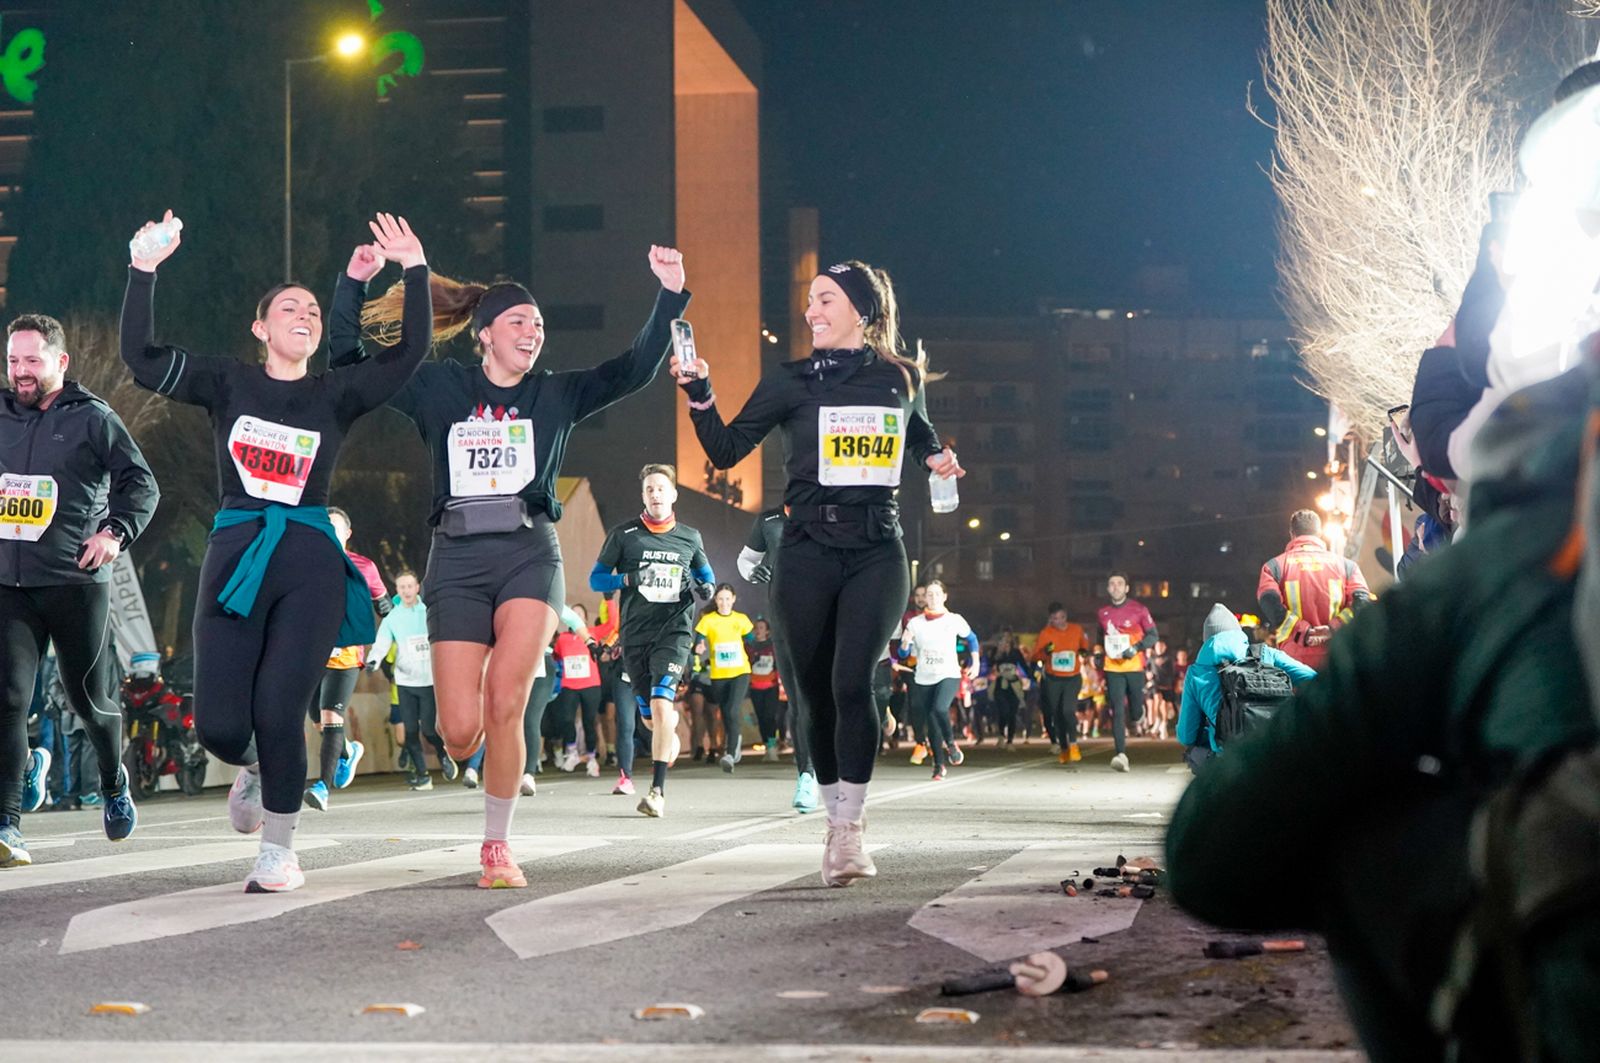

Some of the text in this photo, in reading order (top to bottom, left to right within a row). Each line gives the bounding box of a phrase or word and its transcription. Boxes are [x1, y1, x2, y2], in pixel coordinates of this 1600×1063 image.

[840, 415, 876, 423] NOCHE DE
[830, 425, 847, 433] SAN
[240, 433, 257, 444] SAN
[831, 435, 894, 458] 13644
[466, 446, 517, 469] 7326
[642, 550, 681, 562] RUSTER
